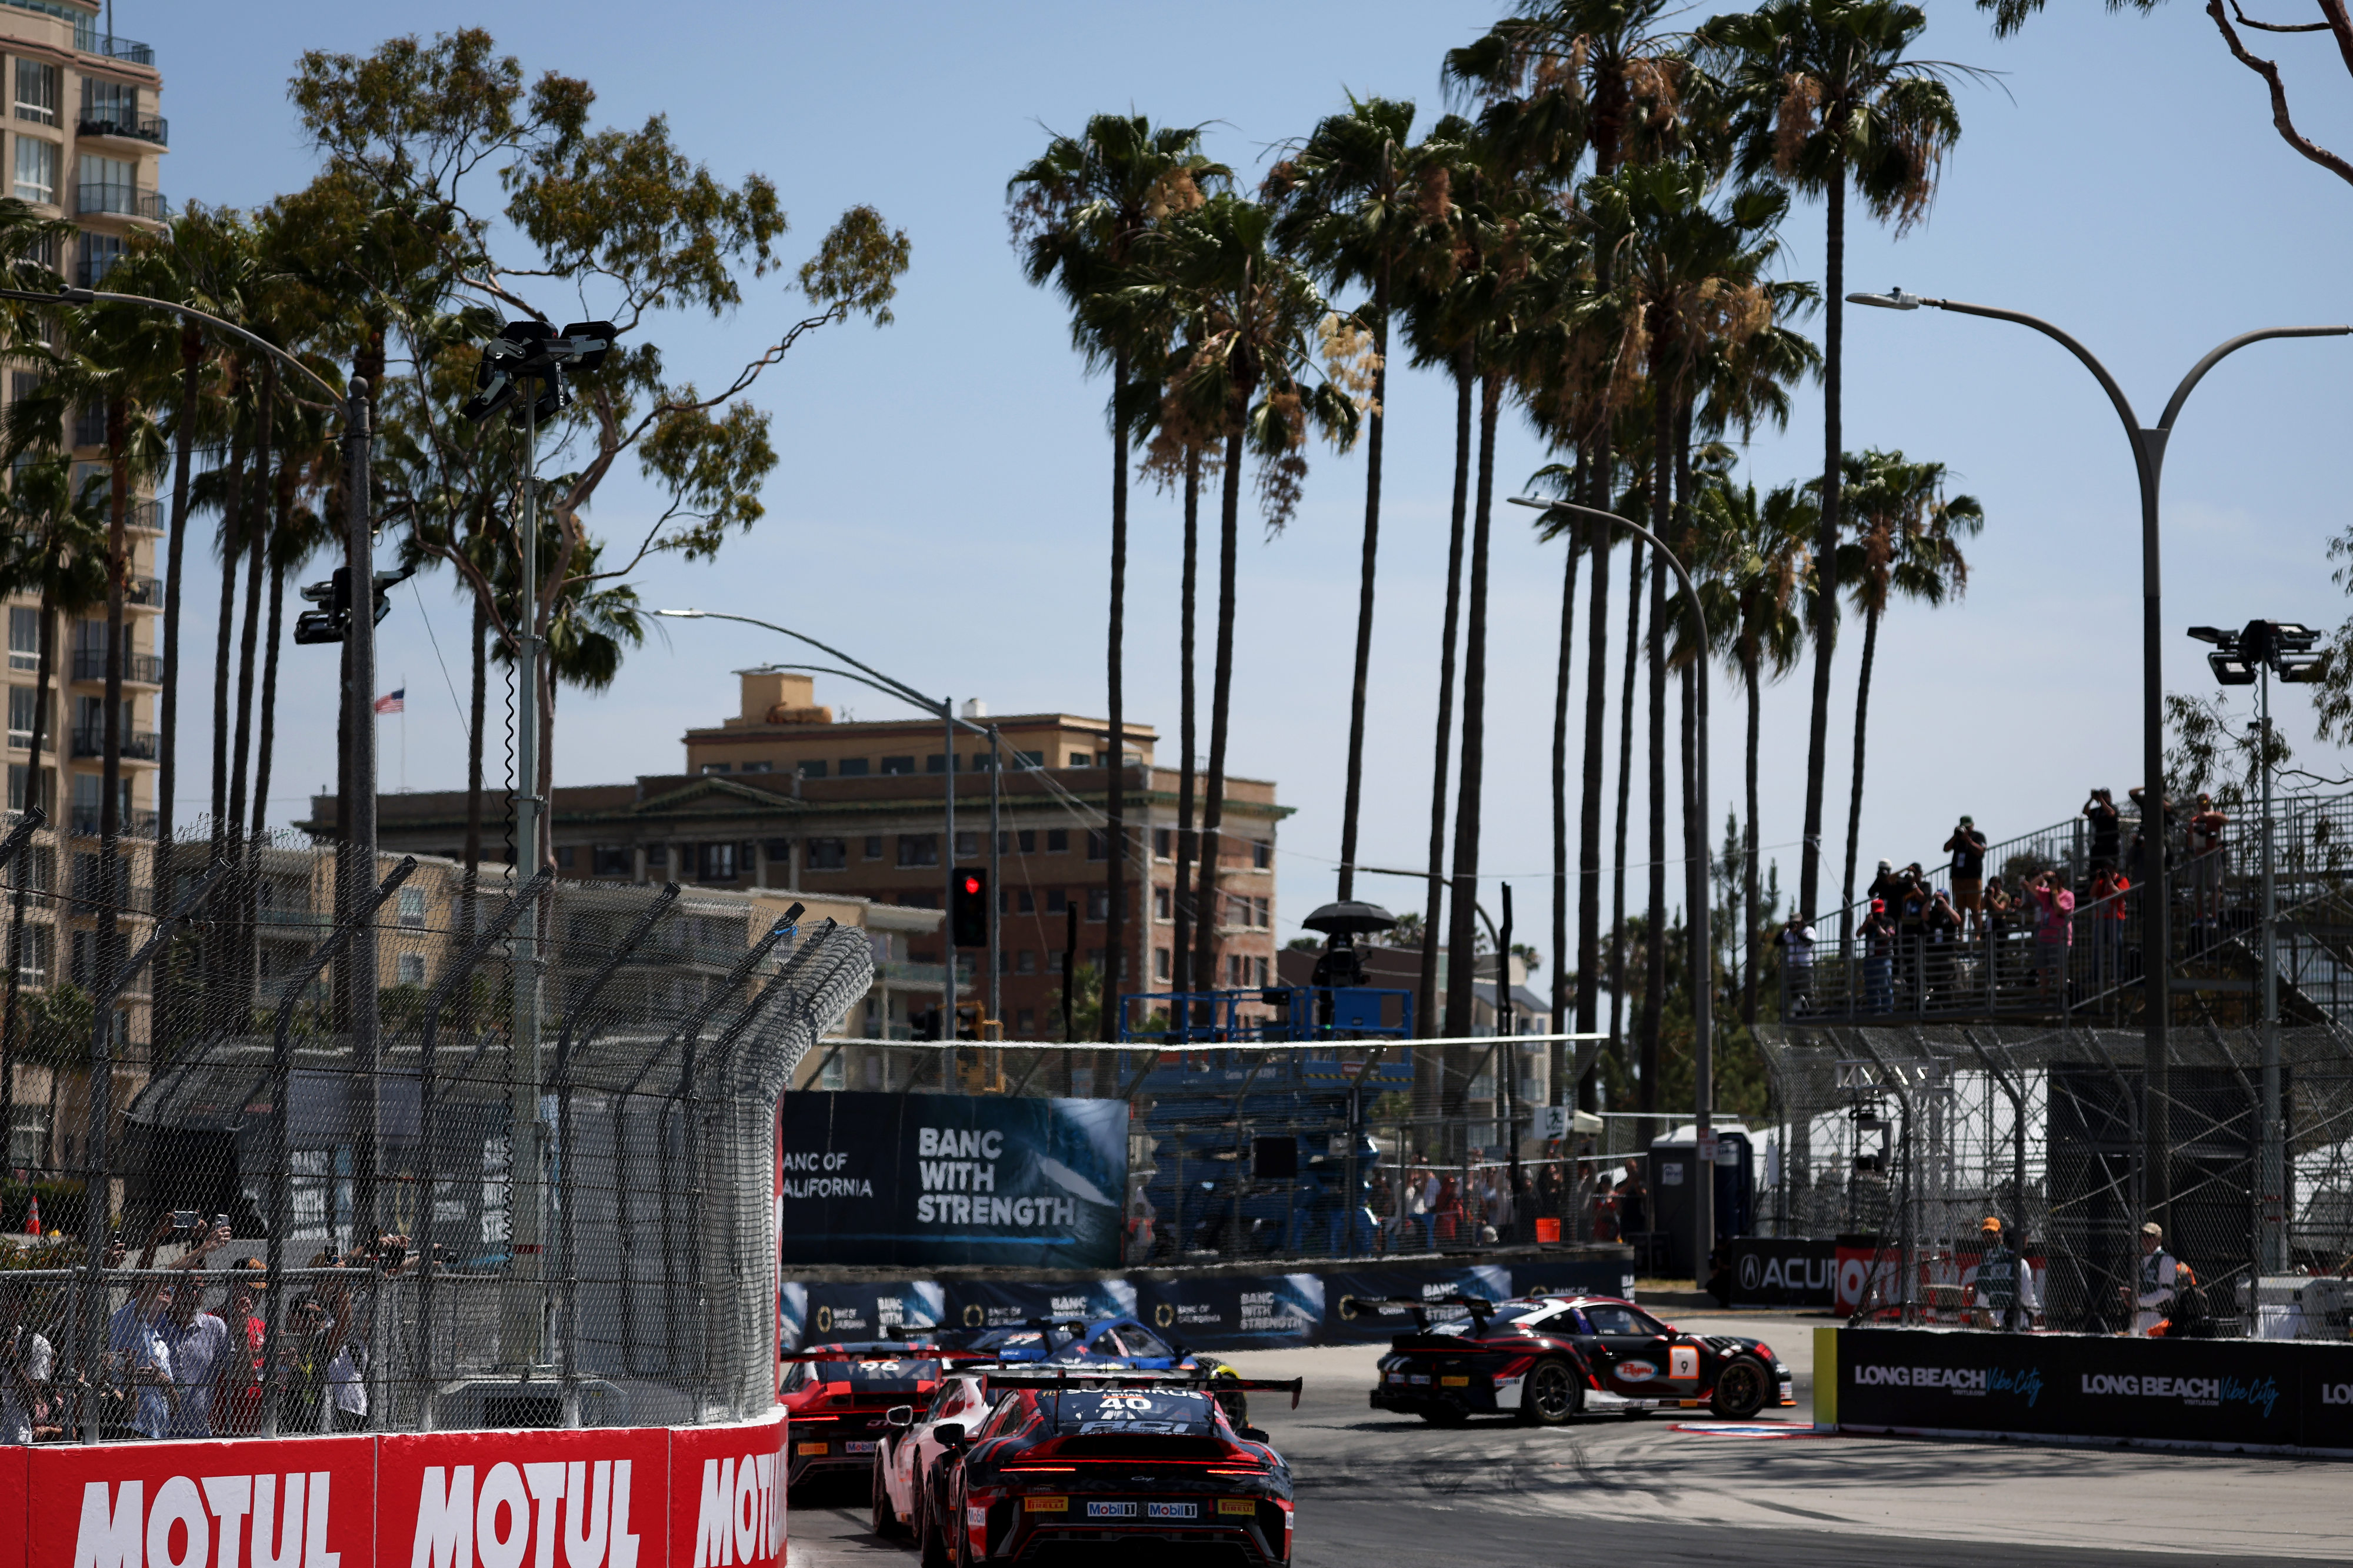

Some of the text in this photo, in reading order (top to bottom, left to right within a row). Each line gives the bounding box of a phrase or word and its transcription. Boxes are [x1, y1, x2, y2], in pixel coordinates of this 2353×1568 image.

[919, 1127, 1003, 1159] BANC
[823, 1152, 848, 1170] OF
[919, 1161, 995, 1192] WITH
[917, 1195, 1075, 1226] STRENGTH
[1422, 1283, 1458, 1296] BANC
[860, 1360, 899, 1372] 96
[1681, 1361, 1688, 1373] 9
[1855, 1365, 2044, 1407] LONG BEACH Vibe City
[1099, 1397, 1152, 1410] 40
[2082, 1374, 2279, 1418] LONG BEACH Vibe City
[1027, 1499, 1064, 1510] PIRELLI
[1089, 1503, 1124, 1516] Mobil
[1149, 1503, 1184, 1517] Mobil
[1221, 1502, 1254, 1513] PIRELLI
[74, 1471, 341, 1568] MOTUL
[412, 1459, 640, 1568] MOTUL
